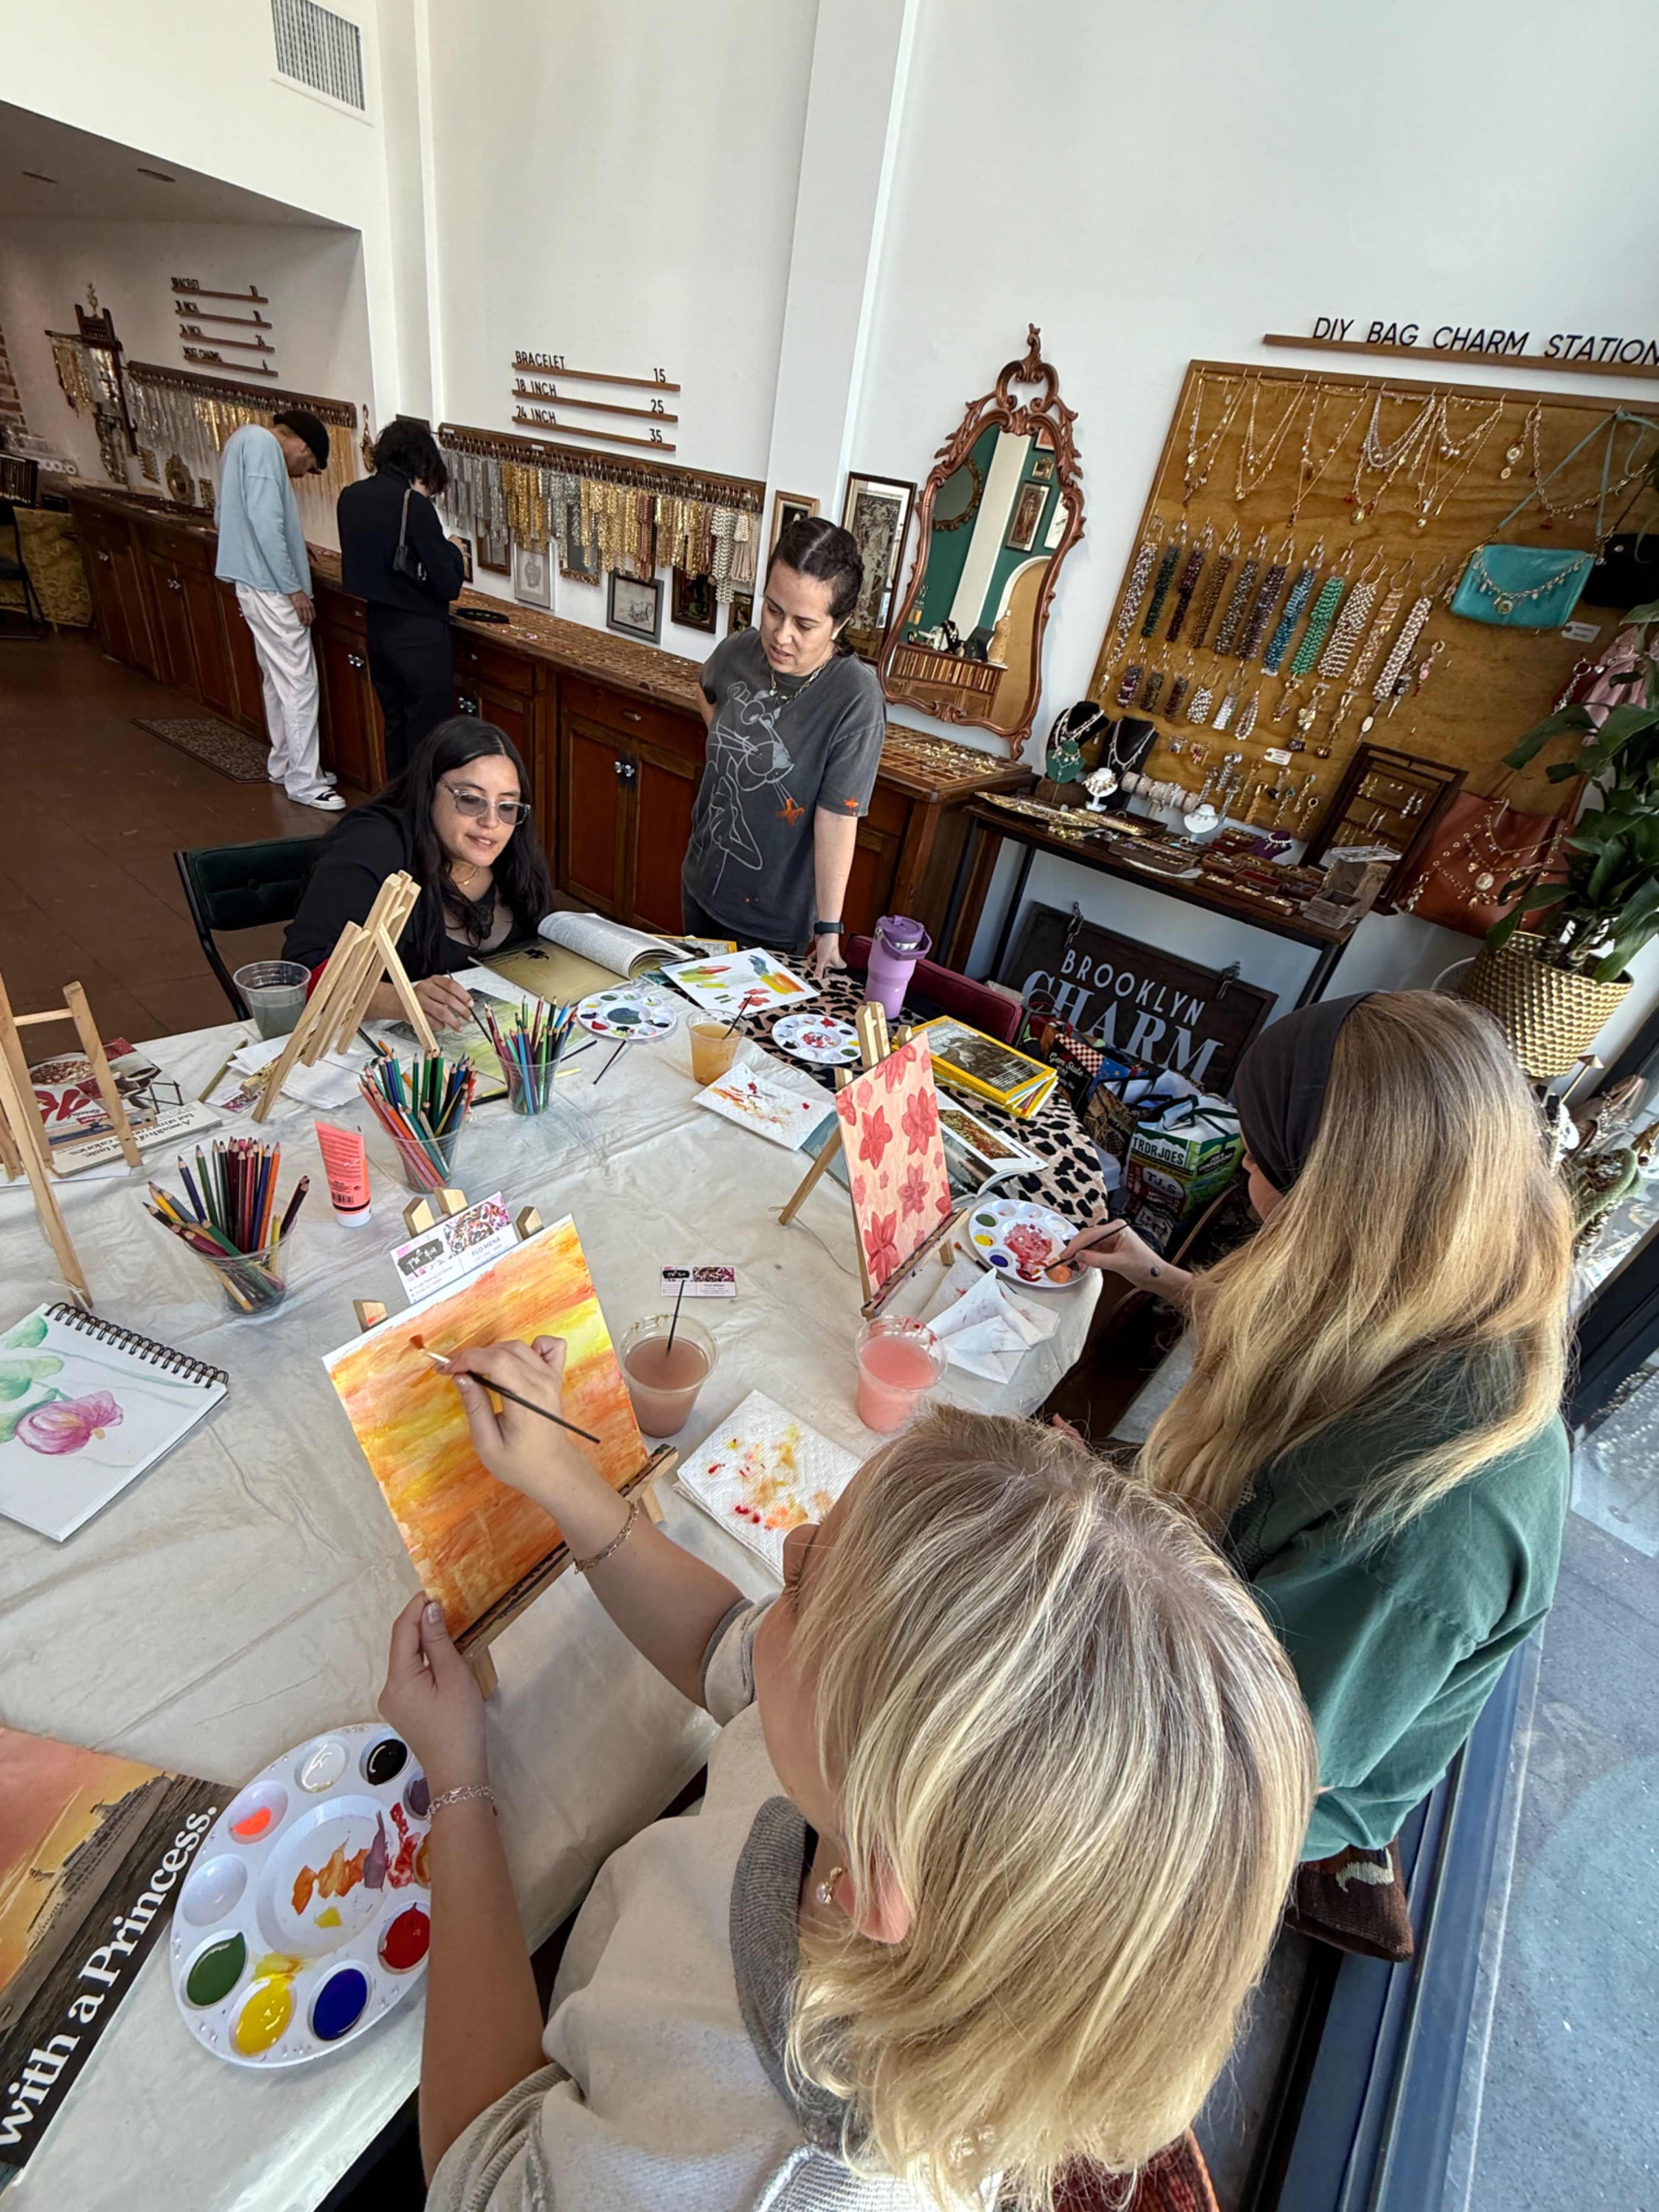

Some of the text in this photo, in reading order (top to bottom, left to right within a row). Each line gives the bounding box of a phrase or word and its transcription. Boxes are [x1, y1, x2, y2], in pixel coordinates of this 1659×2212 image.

[1313, 317, 1659, 365] DIY BAG CHARM STATION
[515, 351, 666, 383] BRACELET 15
[516, 378, 664, 414] 18 INCH 25
[516, 405, 662, 444] 24 INCH 35
[1061, 949, 1205, 1027] BROOKLYN
[1021, 969, 1224, 1086] CHARM
[1131, 1136, 1158, 1157] TRDR
[1157, 1147, 1184, 1165] JOES
[0, 1806, 217, 2145] with a Princess.
